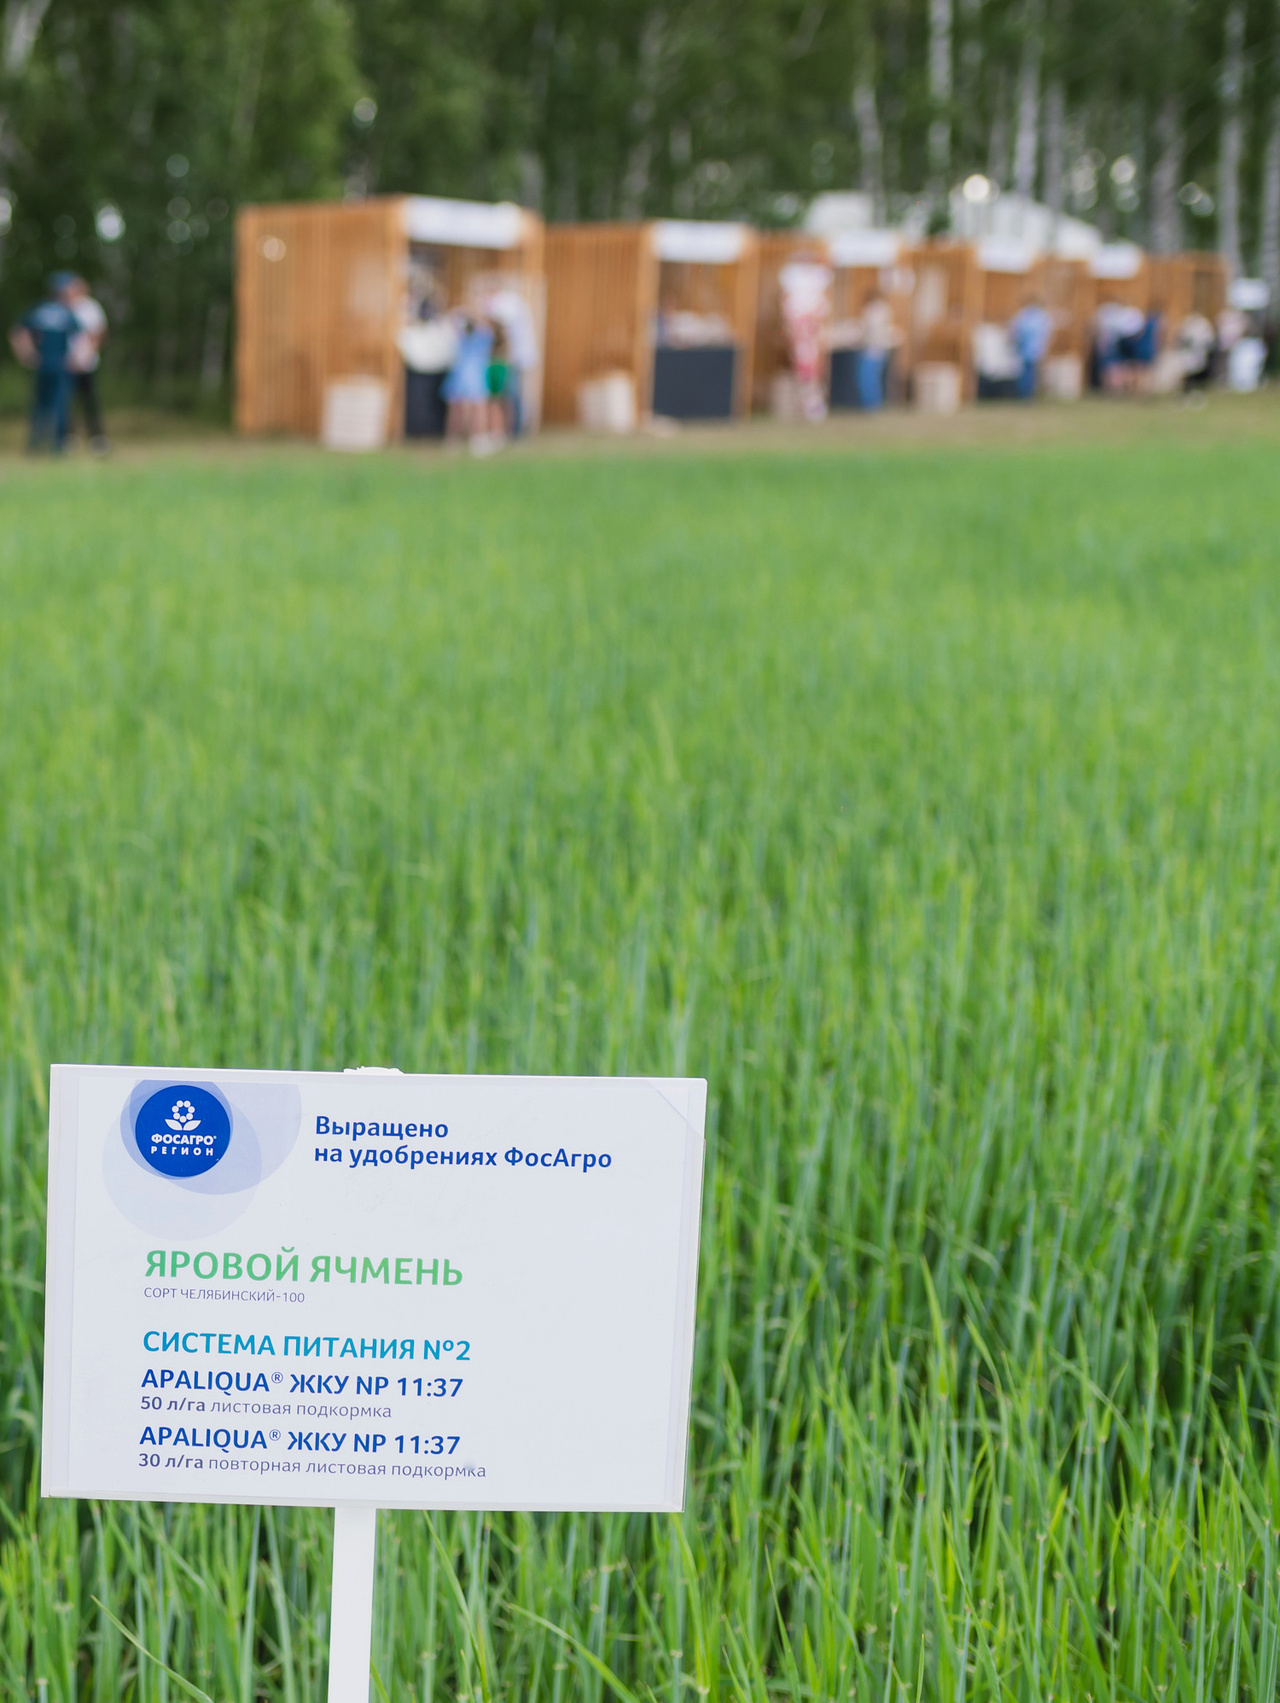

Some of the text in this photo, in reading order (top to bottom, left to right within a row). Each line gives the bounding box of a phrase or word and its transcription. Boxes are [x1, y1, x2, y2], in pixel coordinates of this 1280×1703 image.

[315, 1115, 449, 1142] Выращено
[150, 1145, 214, 1157] РЕГИОН
[314, 1144, 612, 1172] на удобрениях ФосАгро
[144, 1246, 463, 1286] ЯРОВОЙ ЯЧМЕНЬ
[143, 1286, 305, 1303] СОРТ ЧЕЛЯБИНСКИЙ-100
[143, 1330, 276, 1356] СИСТЕМА
[283, 1335, 415, 1360] ПИТАНИЯ
[289, 1373, 349, 1395] ЖКУ
[356, 1375, 389, 1396] NP
[397, 1377, 464, 1398] 11:37
[140, 1395, 392, 1421] 50 л/га листовая подкормка
[287, 1431, 347, 1452] ЖКУ
[353, 1433, 387, 1453] NP
[394, 1434, 461, 1455] 11:37
[138, 1452, 486, 1481] 30 л/га повторная листовая подкормка
